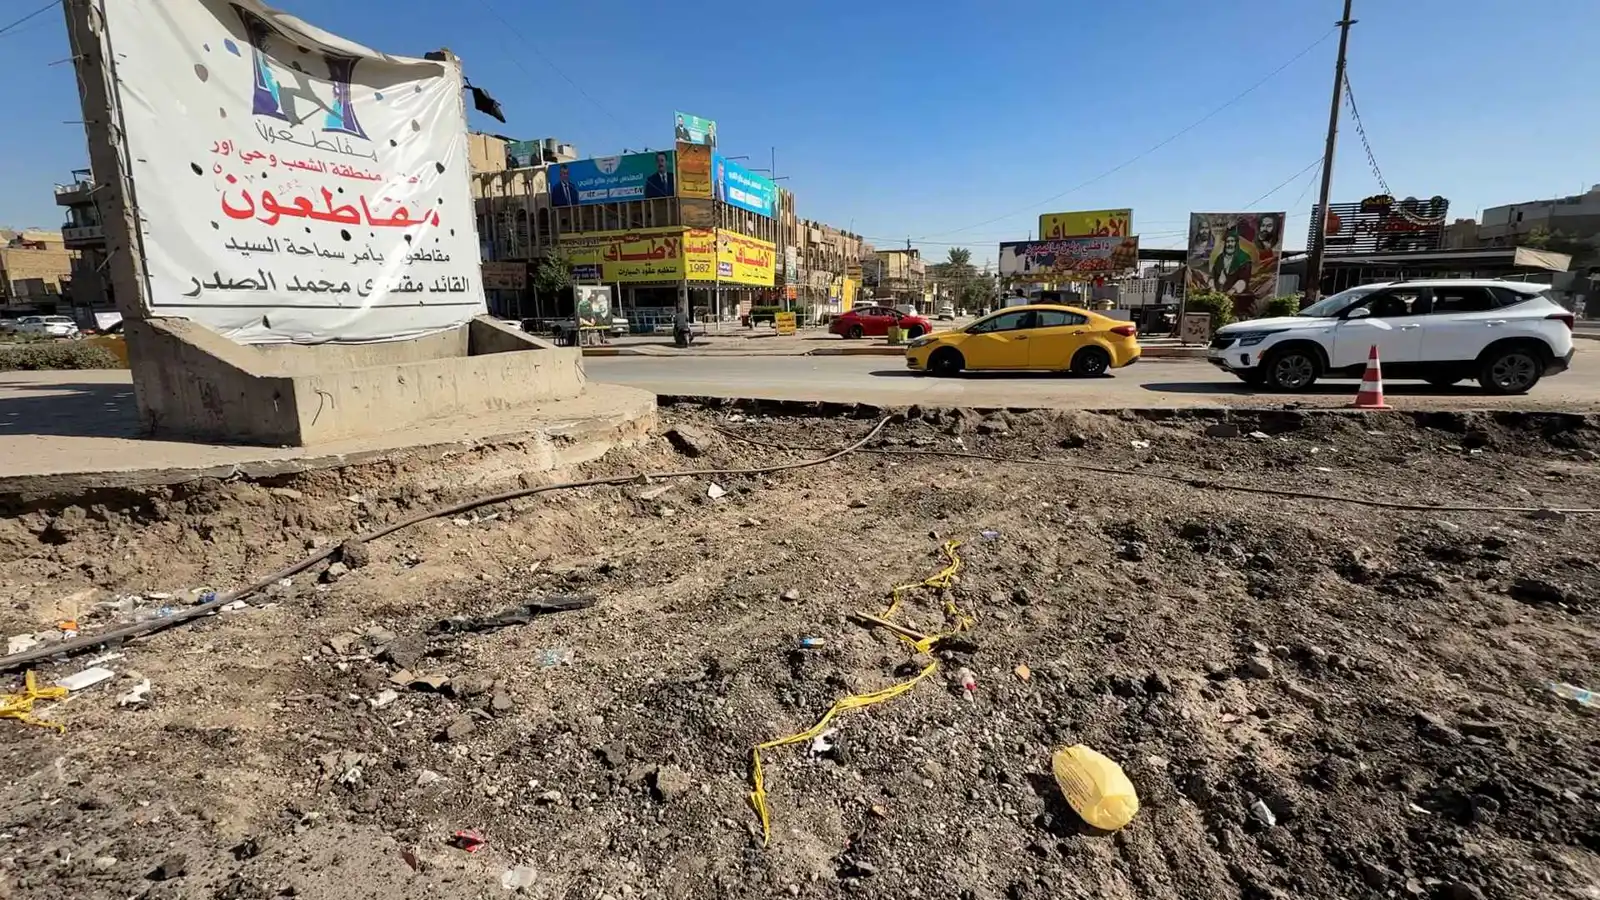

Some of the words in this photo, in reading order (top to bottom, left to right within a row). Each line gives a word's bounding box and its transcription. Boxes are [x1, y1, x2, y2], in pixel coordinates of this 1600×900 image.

[210, 139, 234, 156] اور
[255, 119, 378, 163] مقاطعون
[281, 157, 328, 174] الشعب
[332, 161, 382, 182] منطقة
[222, 173, 440, 227] مقاطعون
[224, 236, 281, 256] السيد
[282, 238, 345, 260] سماحة
[350, 243, 385, 266] بأمر
[404, 247, 451, 265] مقاطعو
[689, 263, 711, 274] 1982
[180, 267, 277, 298] الصدر
[285, 274, 352, 294] محمد
[428, 275, 471, 294] القائد
